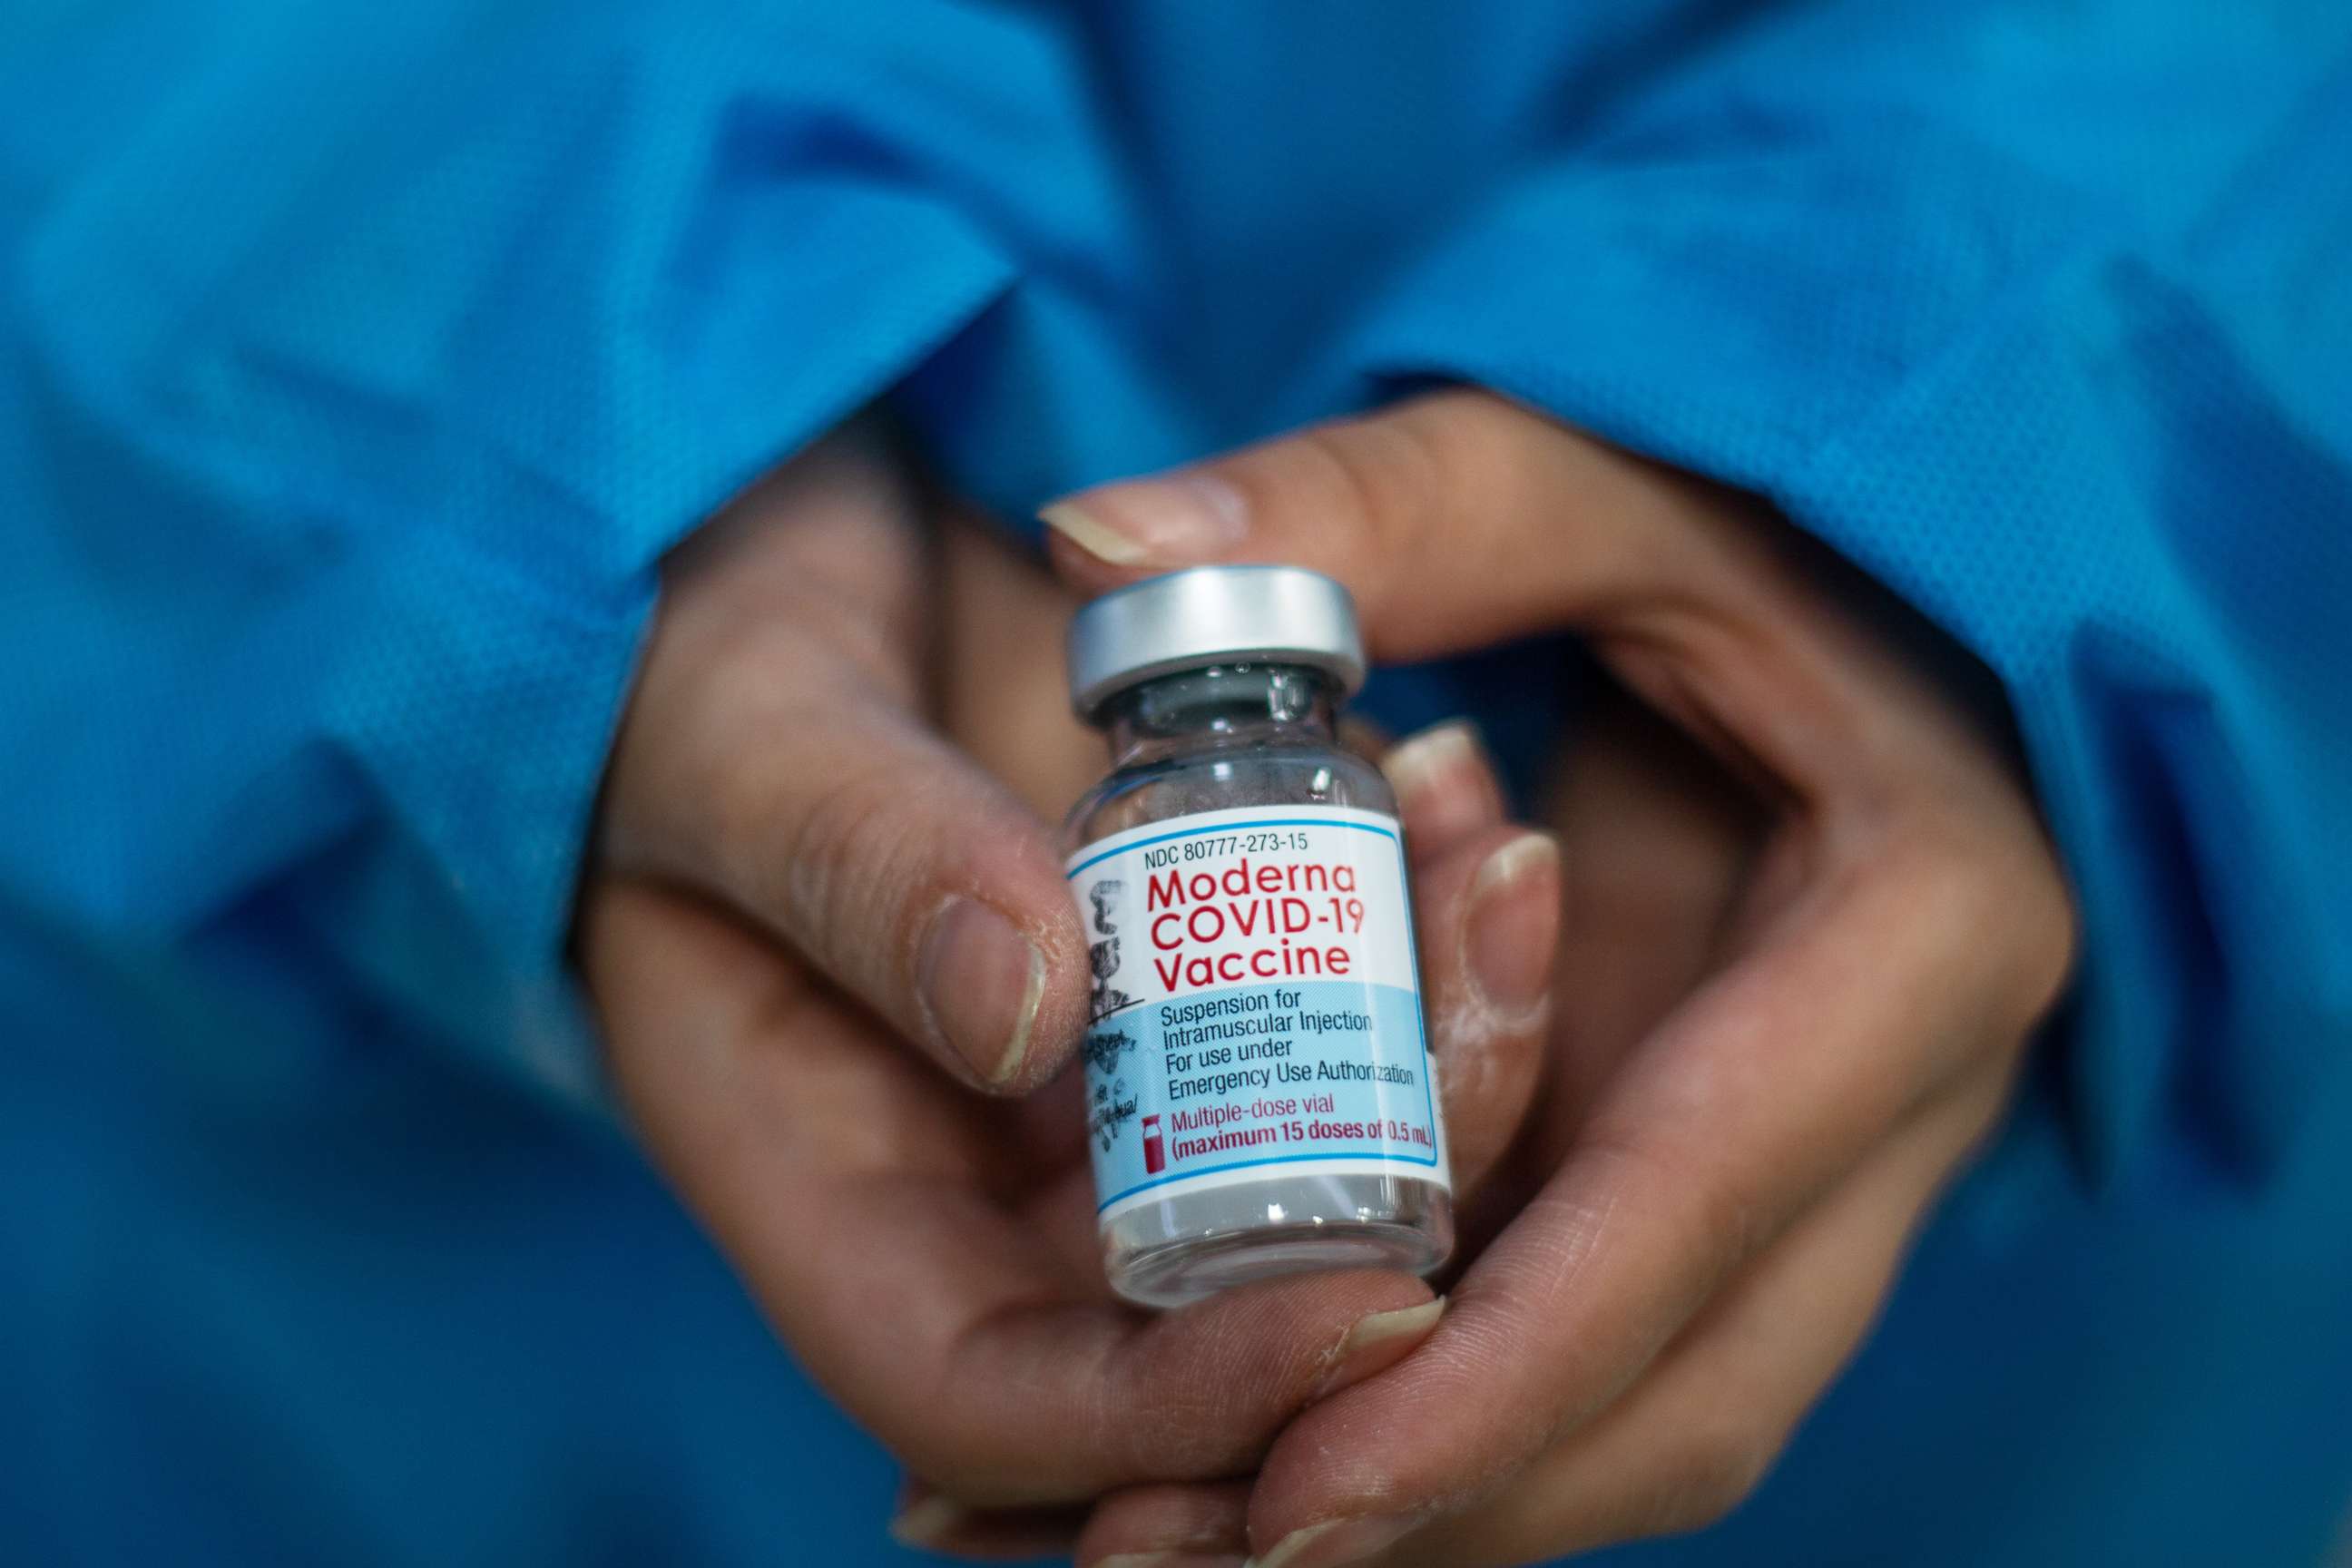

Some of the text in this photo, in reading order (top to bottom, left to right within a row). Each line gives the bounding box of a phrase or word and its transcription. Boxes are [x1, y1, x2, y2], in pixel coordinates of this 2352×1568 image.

[1144, 833, 1308, 869] NDC 80777-273-15
[1147, 858, 1356, 912] Moderna
[1151, 897, 1365, 950] COVID-19
[1154, 939, 1350, 992] Vaccine
[1161, 988, 1302, 1027] Suspension for
[1163, 1011, 1373, 1050] Intramuscular Injection
[1165, 1039, 1293, 1074] For use under
[1168, 1060, 1414, 1101] Emergency Use Authorization
[1171, 1093, 1335, 1133] Multiple-dose vial
[1172, 1126, 1276, 1161] (maximum
[1279, 1121, 1304, 1141] 15
[1308, 1119, 1363, 1139] doses
[1367, 1119, 1383, 1138] of
[1387, 1120, 1409, 1140] 0.5
